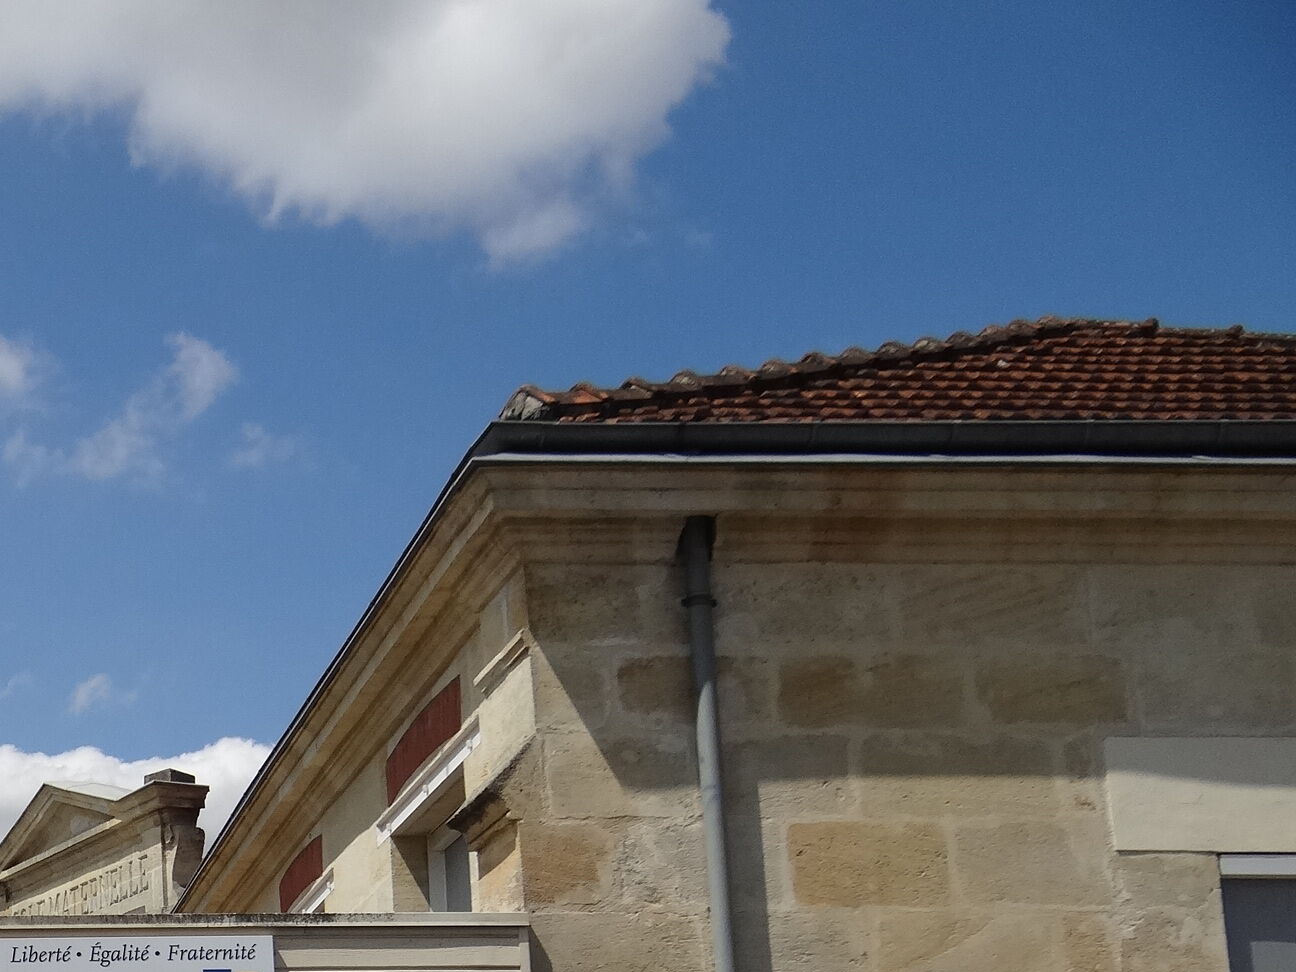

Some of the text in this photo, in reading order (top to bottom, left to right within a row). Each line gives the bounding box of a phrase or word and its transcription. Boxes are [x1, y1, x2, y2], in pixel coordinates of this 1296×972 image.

[10, 942, 256, 967] Liberté Égalité Fraternité
